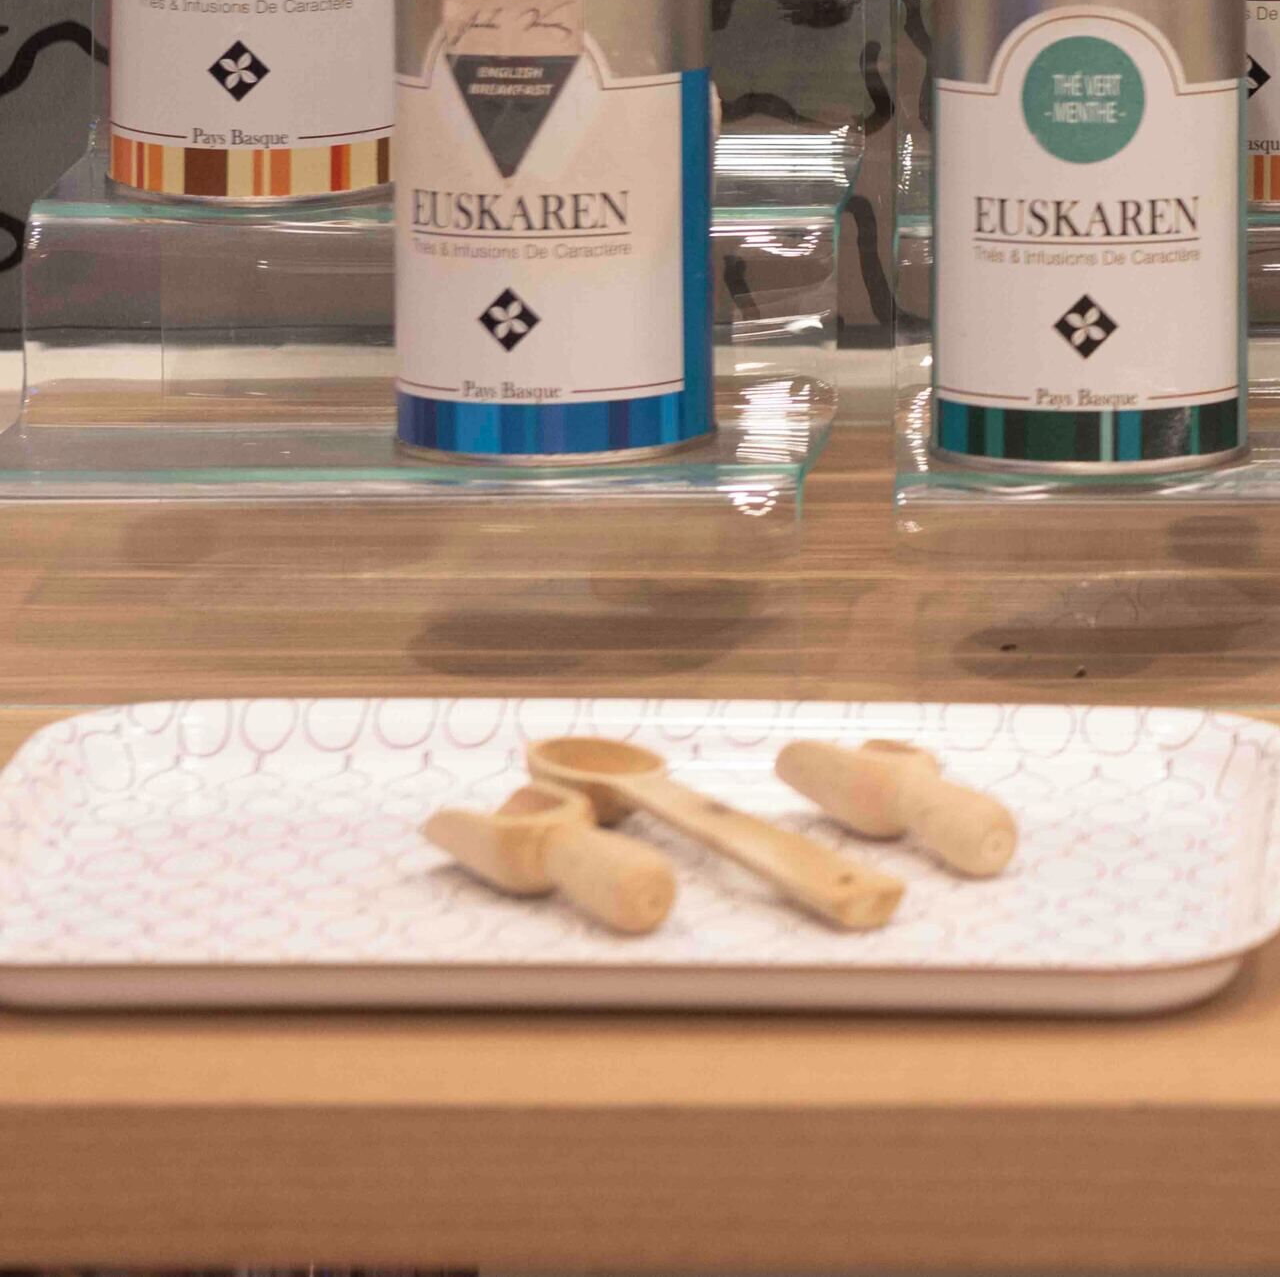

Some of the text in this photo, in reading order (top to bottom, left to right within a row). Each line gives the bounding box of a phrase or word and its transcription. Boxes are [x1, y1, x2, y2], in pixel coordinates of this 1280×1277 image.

[256, 0, 278, 14] De
[1257, 6, 1277, 21] De
[1051, 70, 1122, 96] THÉ VERT
[192, 127, 289, 148] Pays Basque
[412, 188, 629, 231] EUSKAREN
[974, 196, 1200, 238] EUSKAREN
[525, 245, 549, 259] De
[1103, 251, 1126, 266] De
[463, 380, 562, 405] Pays Basque
[1036, 387, 1139, 410] Pays Basque
